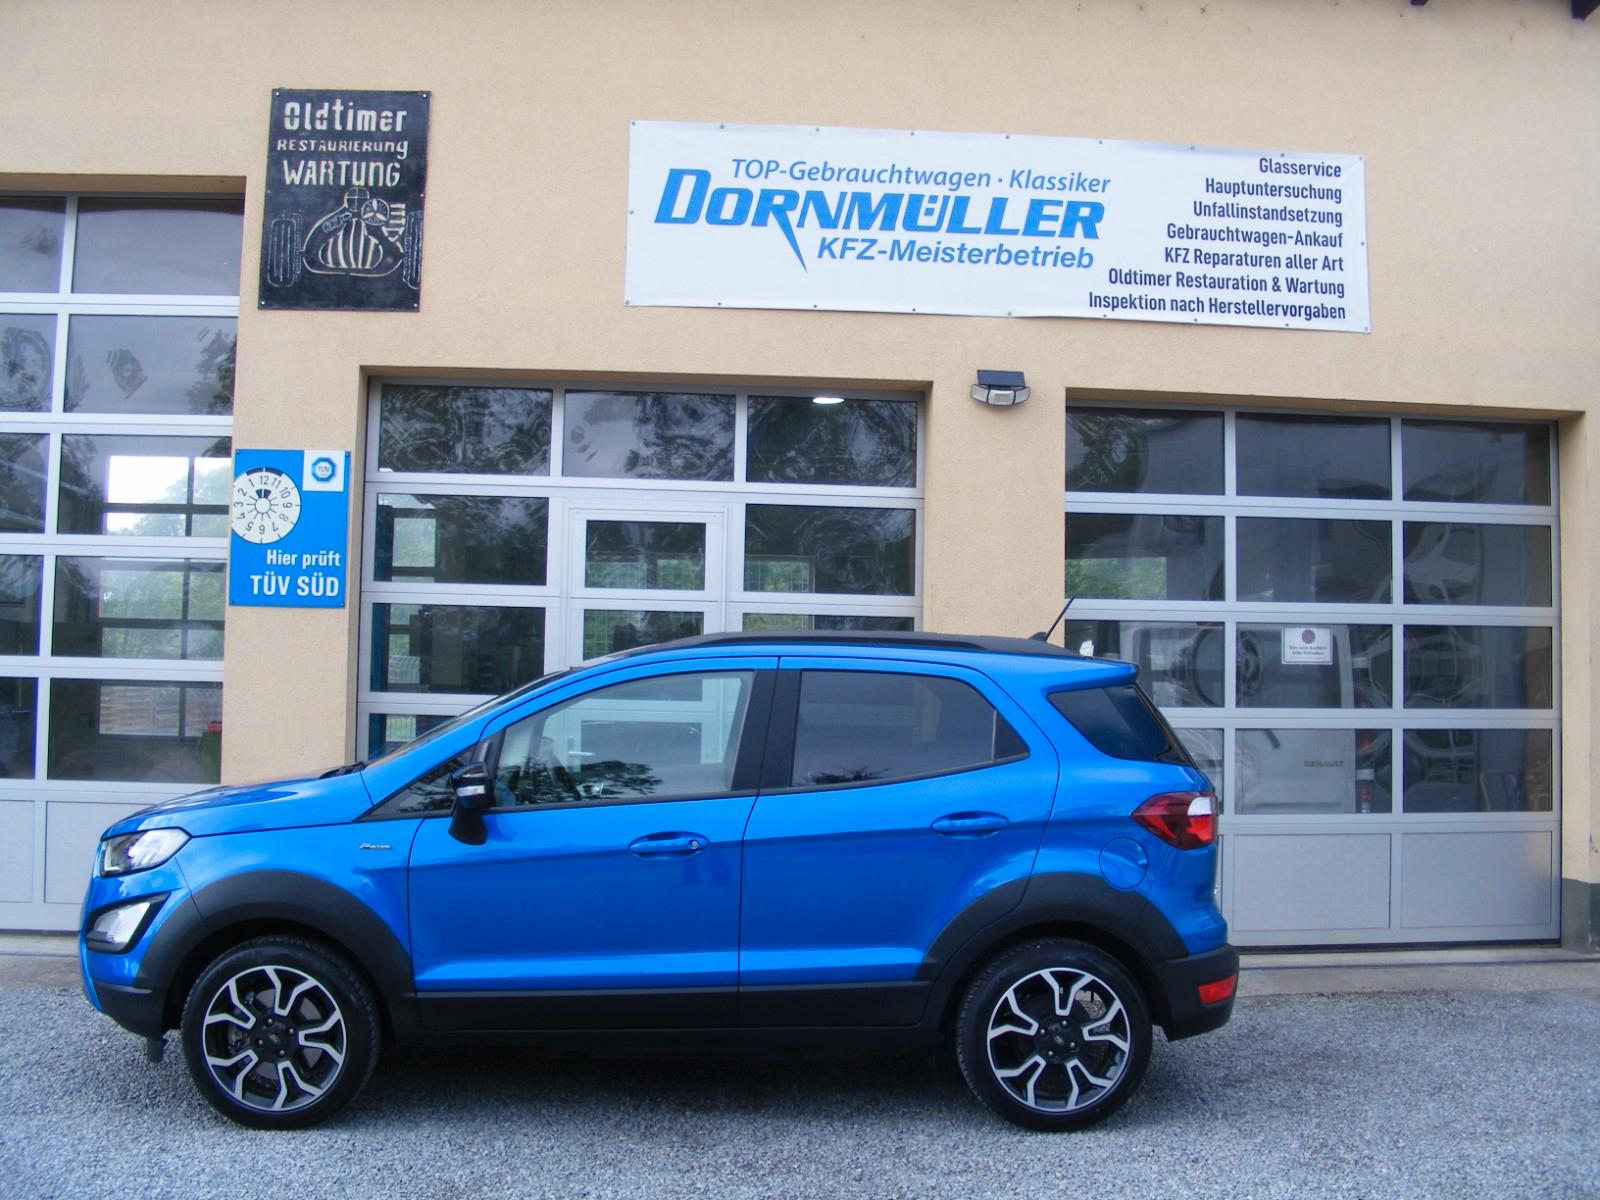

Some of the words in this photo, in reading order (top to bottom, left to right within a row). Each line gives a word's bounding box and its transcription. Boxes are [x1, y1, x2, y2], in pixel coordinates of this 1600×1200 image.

[283, 98, 408, 132] Oldtimer
[731, 158, 991, 190] TOP-Gebrauchtwagen
[1008, 168, 1111, 194] Klassiker
[1259, 157, 1342, 178] Glasservice
[1205, 178, 1343, 204] Hauptuntersuchung
[654, 168, 1105, 273] DORNMÜLLER
[1193, 201, 1343, 228] Unfallinstandsetzung
[1167, 223, 1344, 248] Gebrauchtwagen-Ankauf
[817, 236, 1095, 269] KFZ-Meisterbetrieb
[1164, 247, 1190, 264] KFZ
[1194, 248, 1282, 270] Reparaturen
[1285, 253, 1318, 270] aller
[1322, 255, 1344, 272] Art
[1108, 268, 1172, 287] Oldtimer
[1176, 271, 1268, 292] Restauration
[1271, 276, 1282, 293] &
[1285, 276, 1345, 299] Wartung
[1089, 291, 1166, 312] Inspektion
[1170, 295, 1205, 314] nach
[1208, 297, 1346, 321] Herstellervorgaben
[237, 487, 248, 497] 2
[260, 475, 270, 486] 12
[271, 477, 282, 489] 11
[280, 486, 291, 499] 10
[236, 512, 246, 520] 4
[245, 521, 254, 532] 5
[272, 521, 279, 532] 7
[278, 513, 289, 522] 8
[266, 549, 298, 565] Hier
[302, 550, 341, 569] prüft
[250, 571, 291, 596] TÜV
[296, 572, 339, 597] SÜD
